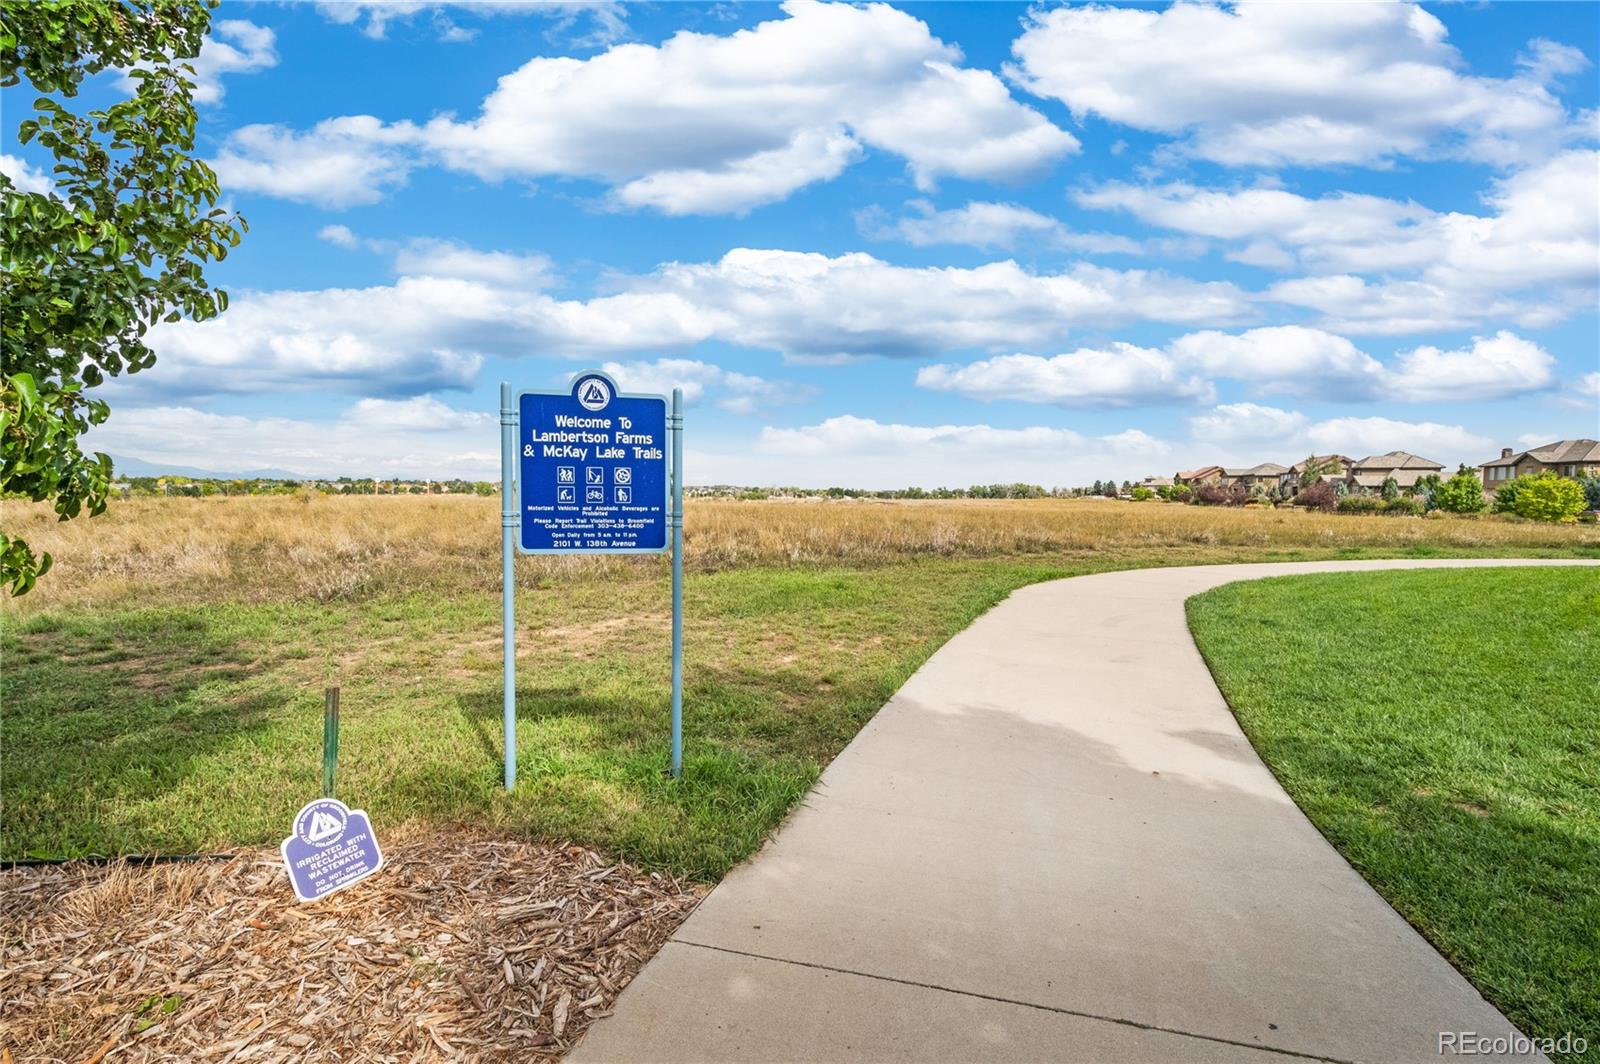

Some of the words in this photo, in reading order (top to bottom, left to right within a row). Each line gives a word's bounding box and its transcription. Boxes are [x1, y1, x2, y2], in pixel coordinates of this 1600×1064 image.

[555, 414, 612, 428] Welcome
[618, 416, 632, 428] To
[532, 430, 608, 443] Lambertson
[616, 432, 653, 444] Farms
[524, 444, 534, 457] &
[544, 445, 588, 461] McKay
[596, 447, 625, 458] Lake
[633, 448, 662, 460] Trails
[296, 844, 342, 868] IRRIGATED
[346, 833, 366, 846] WITH
[310, 844, 358, 870] RECLAIMED
[308, 850, 366, 880] WASTEWATER
[316, 879, 326, 887] DO
[329, 871, 342, 880] NOT
[346, 861, 364, 872] DRINK
[316, 882, 334, 894] FROM
